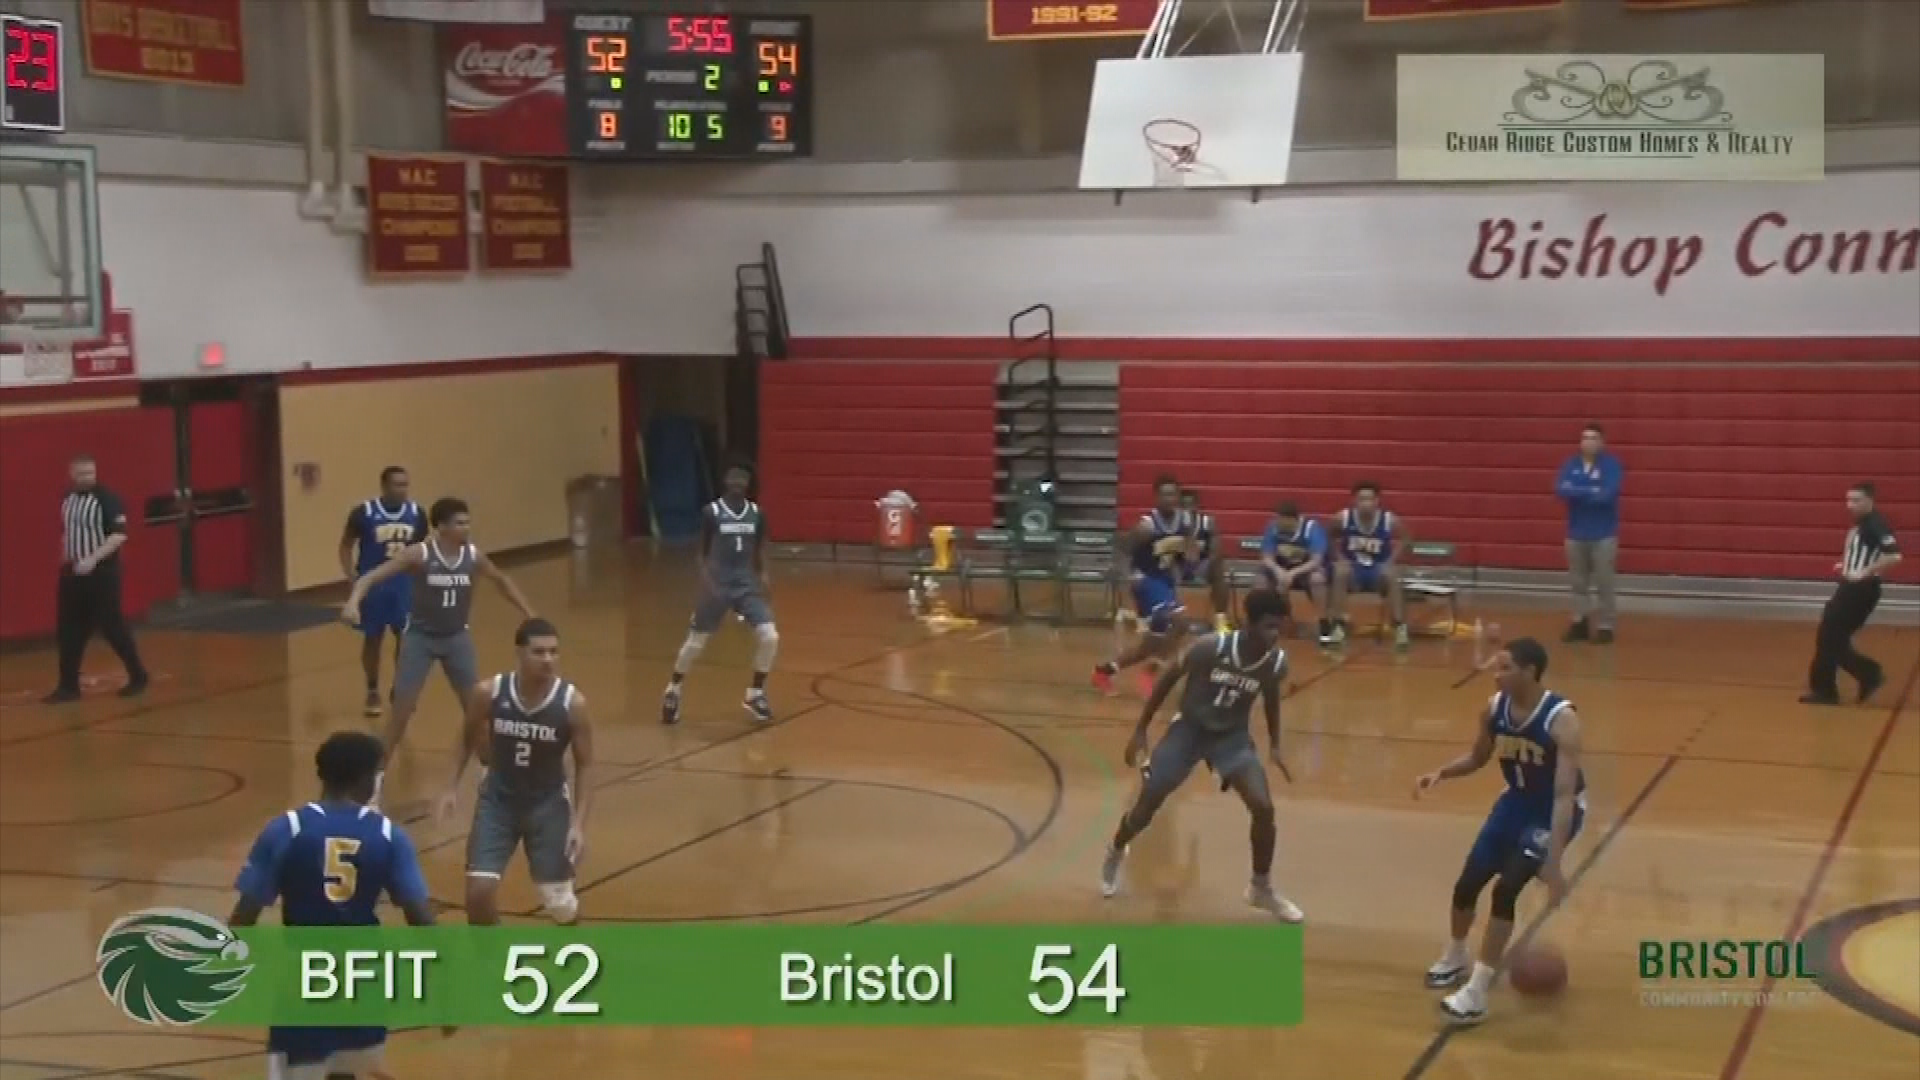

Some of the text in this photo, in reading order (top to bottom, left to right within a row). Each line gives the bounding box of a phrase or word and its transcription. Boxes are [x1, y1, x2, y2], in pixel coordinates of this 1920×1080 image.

[1031, 4, 1119, 25] 1991-92
[668, 17, 735, 53] 5:55
[6, 26, 56, 92] 23
[587, 36, 628, 72] 52
[758, 42, 798, 76] 54
[704, 64, 721, 91] 2
[600, 112, 617, 138] 8
[668, 113, 723, 140] 10 5
[770, 115, 787, 141] 9
[1467, 211, 1920, 296] Bishop Conn
[736, 536, 743, 552] 1
[426, 574, 471, 587] BRISTOL
[442, 589, 457, 607] 11
[494, 717, 559, 742] BRISTOL
[515, 742, 531, 767] 2
[323, 837, 361, 902] 5
